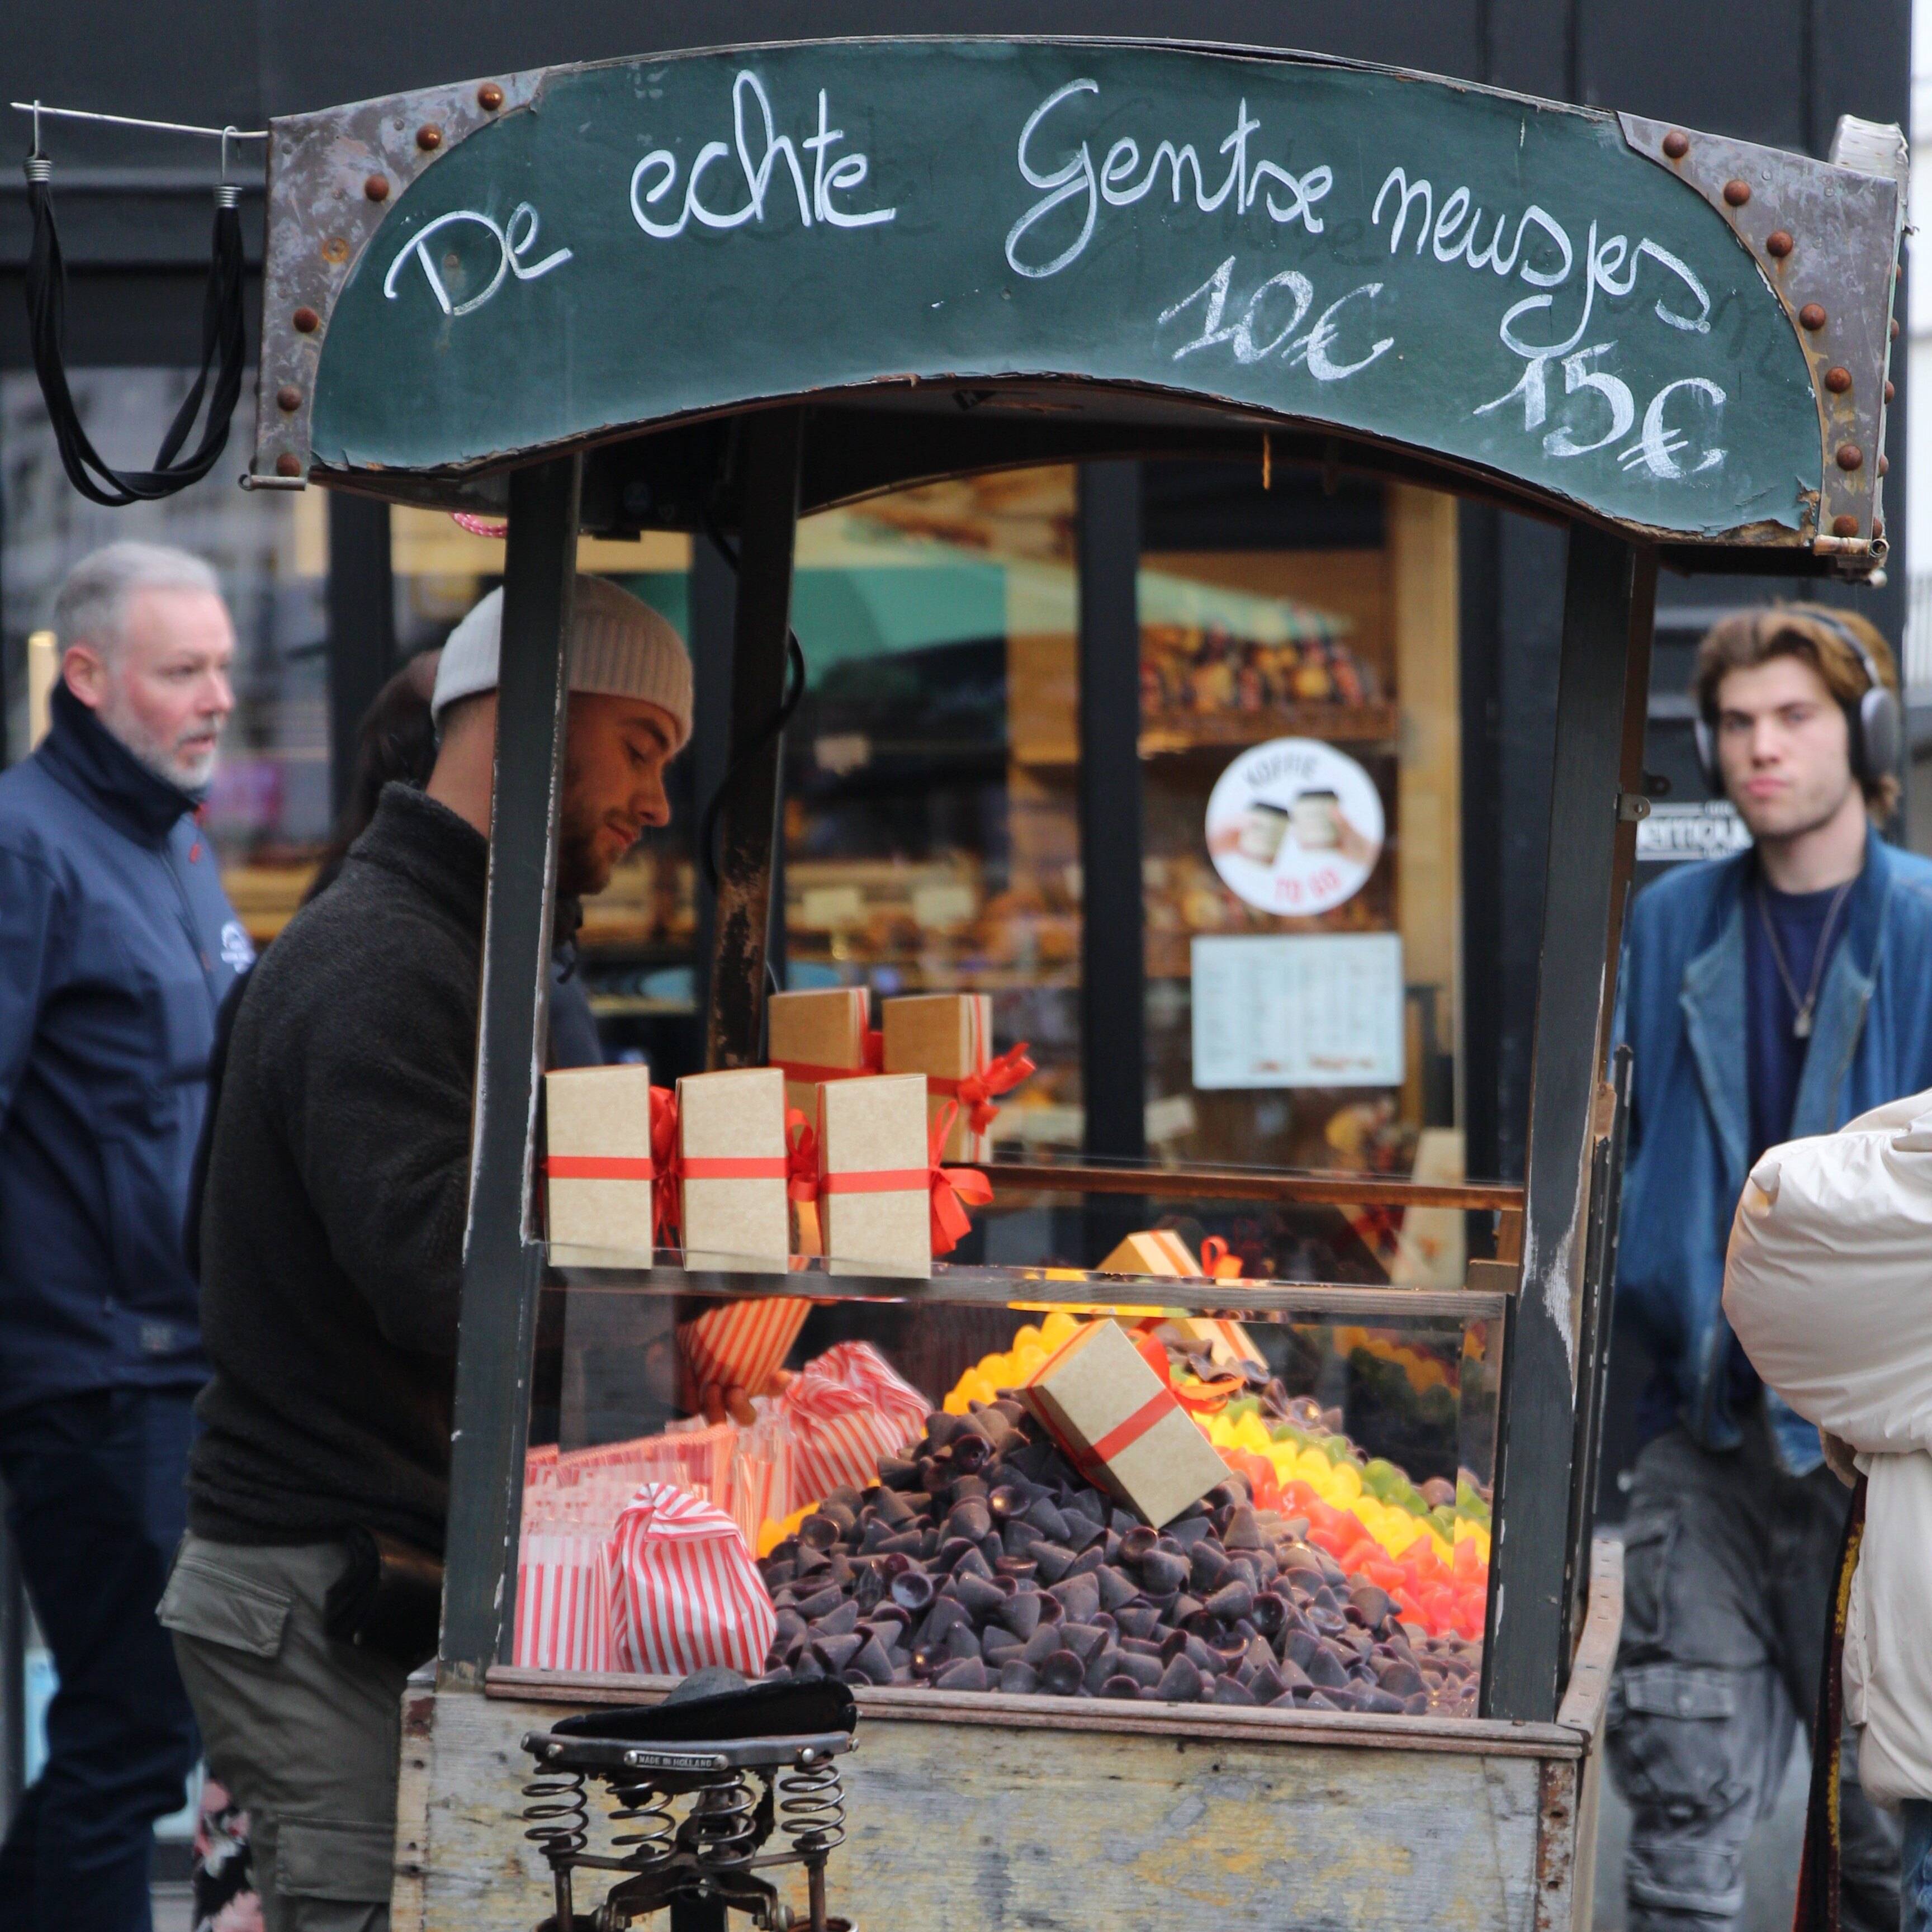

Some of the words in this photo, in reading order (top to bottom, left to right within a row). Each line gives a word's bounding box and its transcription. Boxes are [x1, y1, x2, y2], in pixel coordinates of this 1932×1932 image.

[383, 201, 574, 316] De
[629, 69, 897, 239] echte
[1004, 77, 1334, 279] Gentse
[1370, 166, 1712, 359] neusjes
[1157, 254, 1395, 382] 10€
[1472, 339, 1728, 480] 15€
[638, 1755, 660, 1765] MADE
[662, 1757, 671, 1766] IN
[673, 1758, 712, 1768] HOLLAND
